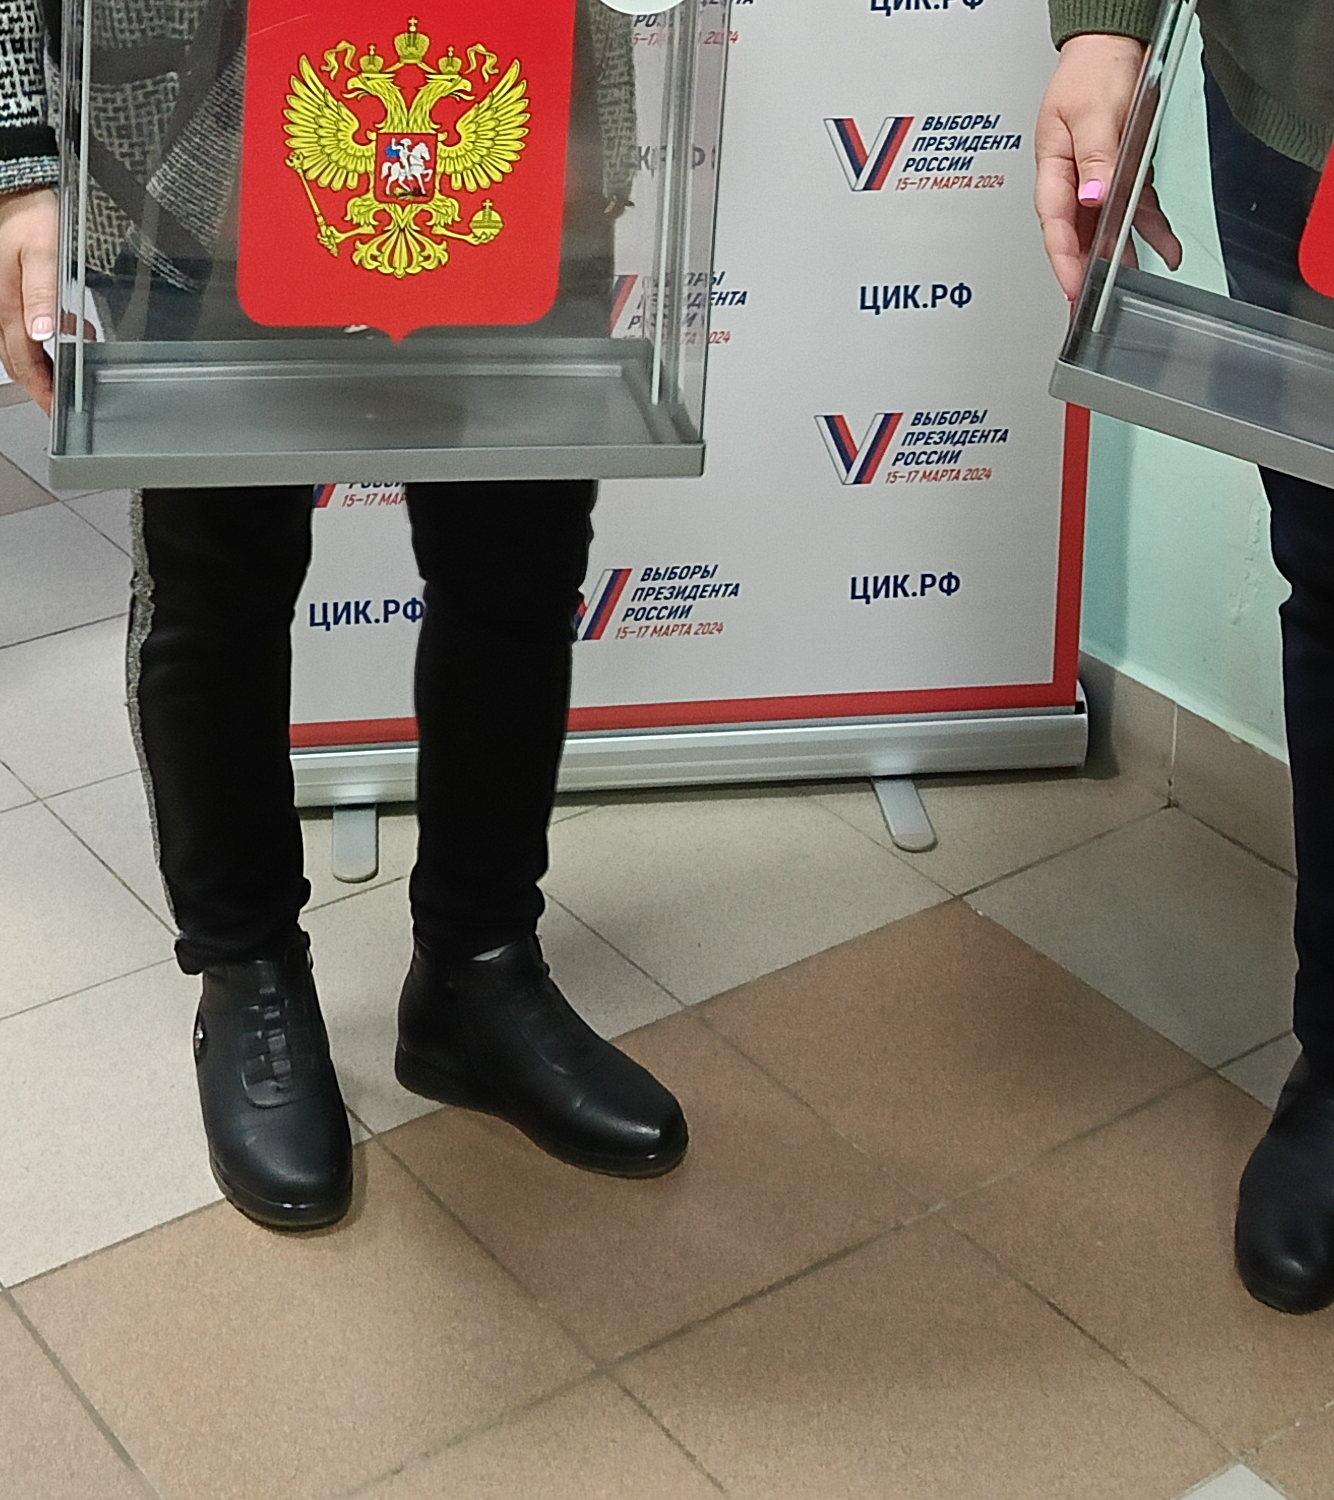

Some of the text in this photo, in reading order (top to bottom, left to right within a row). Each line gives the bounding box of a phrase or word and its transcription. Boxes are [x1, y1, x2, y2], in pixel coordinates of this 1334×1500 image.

[922, 115, 1000, 131] ВЫБОРЫ
[912, 135, 1021, 152] ПРЕЗИДЕНТА
[903, 156, 974, 172] РОССИИ
[930, 176, 973, 189] МАРТА
[974, 175, 1004, 188] 2024
[860, 283, 972, 315] ЦИК.РФ
[911, 410, 988, 426] ВЫБОРЫ
[901, 429, 1009, 446] ПРЕЗИДЕНТА
[892, 450, 962, 466] РОССИИ
[919, 469, 961, 482] МАРТА
[962, 468, 991, 481] 2024
[378, 492, 407, 506] МАР
[640, 565, 718, 582] ВЫБОРЫ
[631, 583, 740, 602] ПРЕЗИДЕНТА
[851, 572, 960, 604] ЦИК.РФ
[310, 597, 424, 631] ЦИК.РФ
[622, 605, 693, 622] РОССИИ
[650, 624, 692, 637] МАРТА
[694, 622, 723, 635] 2024
